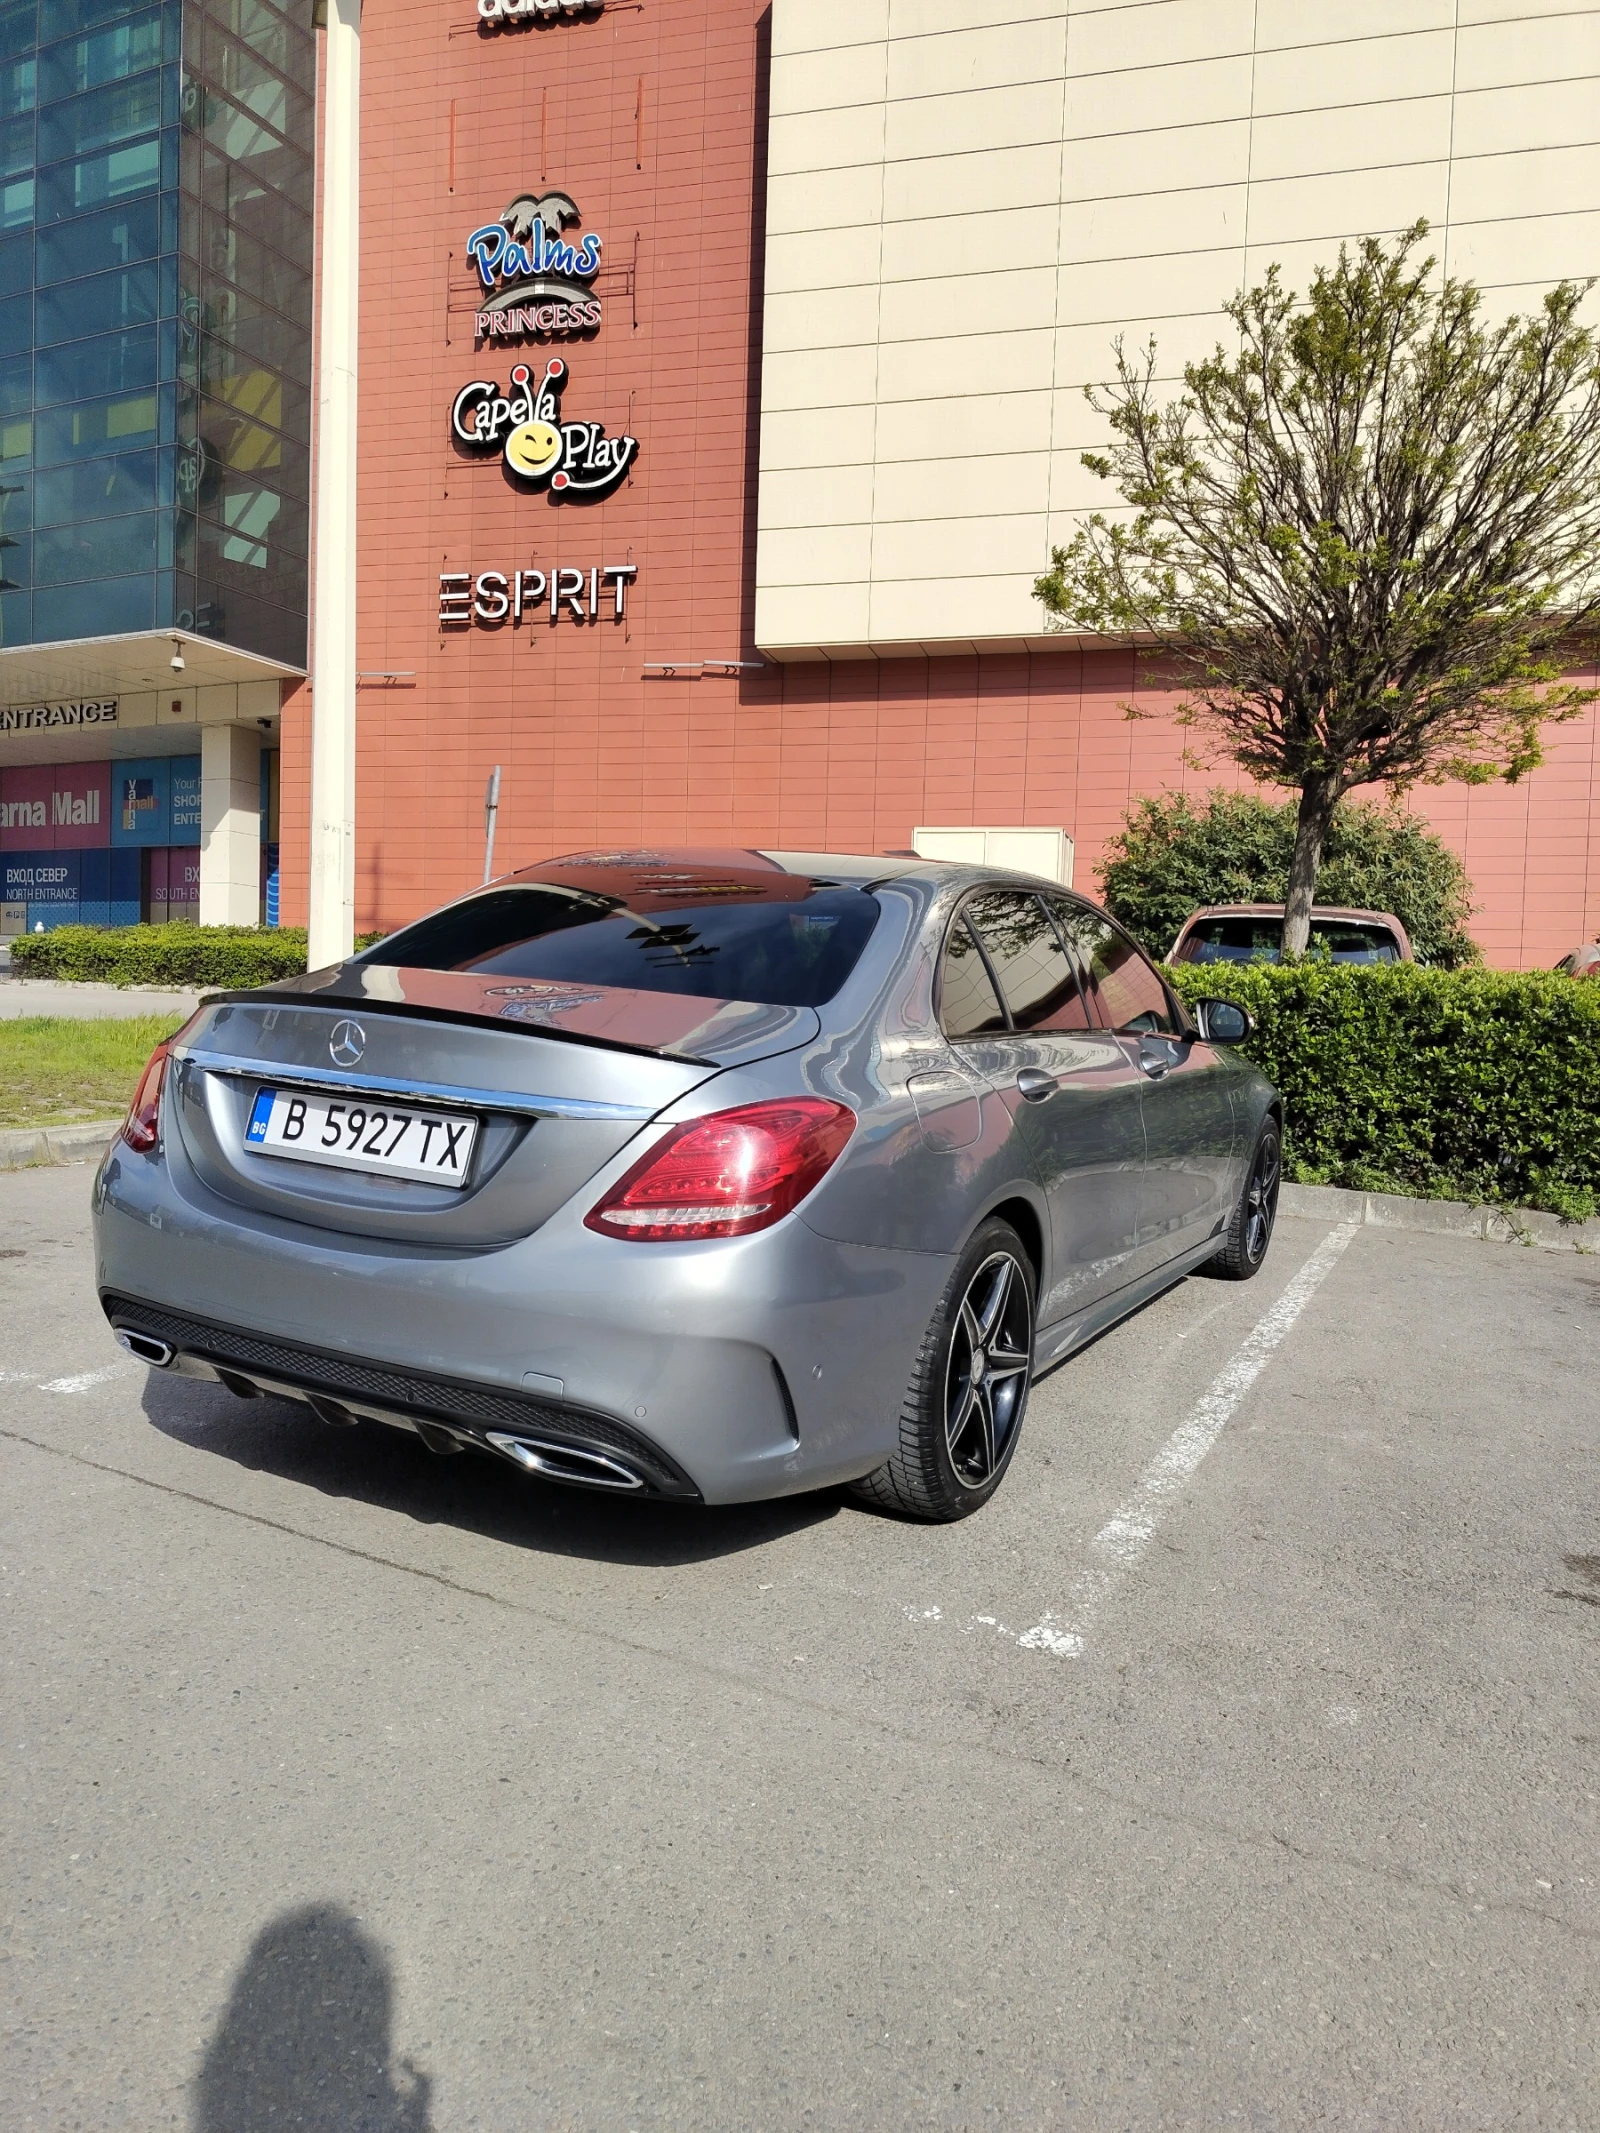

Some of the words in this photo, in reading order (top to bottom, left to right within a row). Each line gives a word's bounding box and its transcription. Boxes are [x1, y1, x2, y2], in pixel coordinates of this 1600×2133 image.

[467, 218, 604, 286] Palms
[474, 300, 602, 337] PRINCESS
[453, 358, 565, 441] Capella
[553, 423, 635, 490] Play
[439, 565, 638, 619] ESPRIT
[0, 701, 116, 729] NTRANCE
[174, 778, 196, 790] Your
[52, 790, 99, 826] Mall
[6, 868, 34, 886] ВХОД
[36, 867, 68, 883] СЕВЕР
[6, 888, 34, 900] NORTH
[35, 887, 78, 900] ENTRANCE
[155, 887, 187, 900] SOUTH
[252, 1121, 267, 1136] BG
[282, 1098, 308, 1141] B
[321, 1104, 412, 1157] 5927
[420, 1119, 467, 1169] TX
